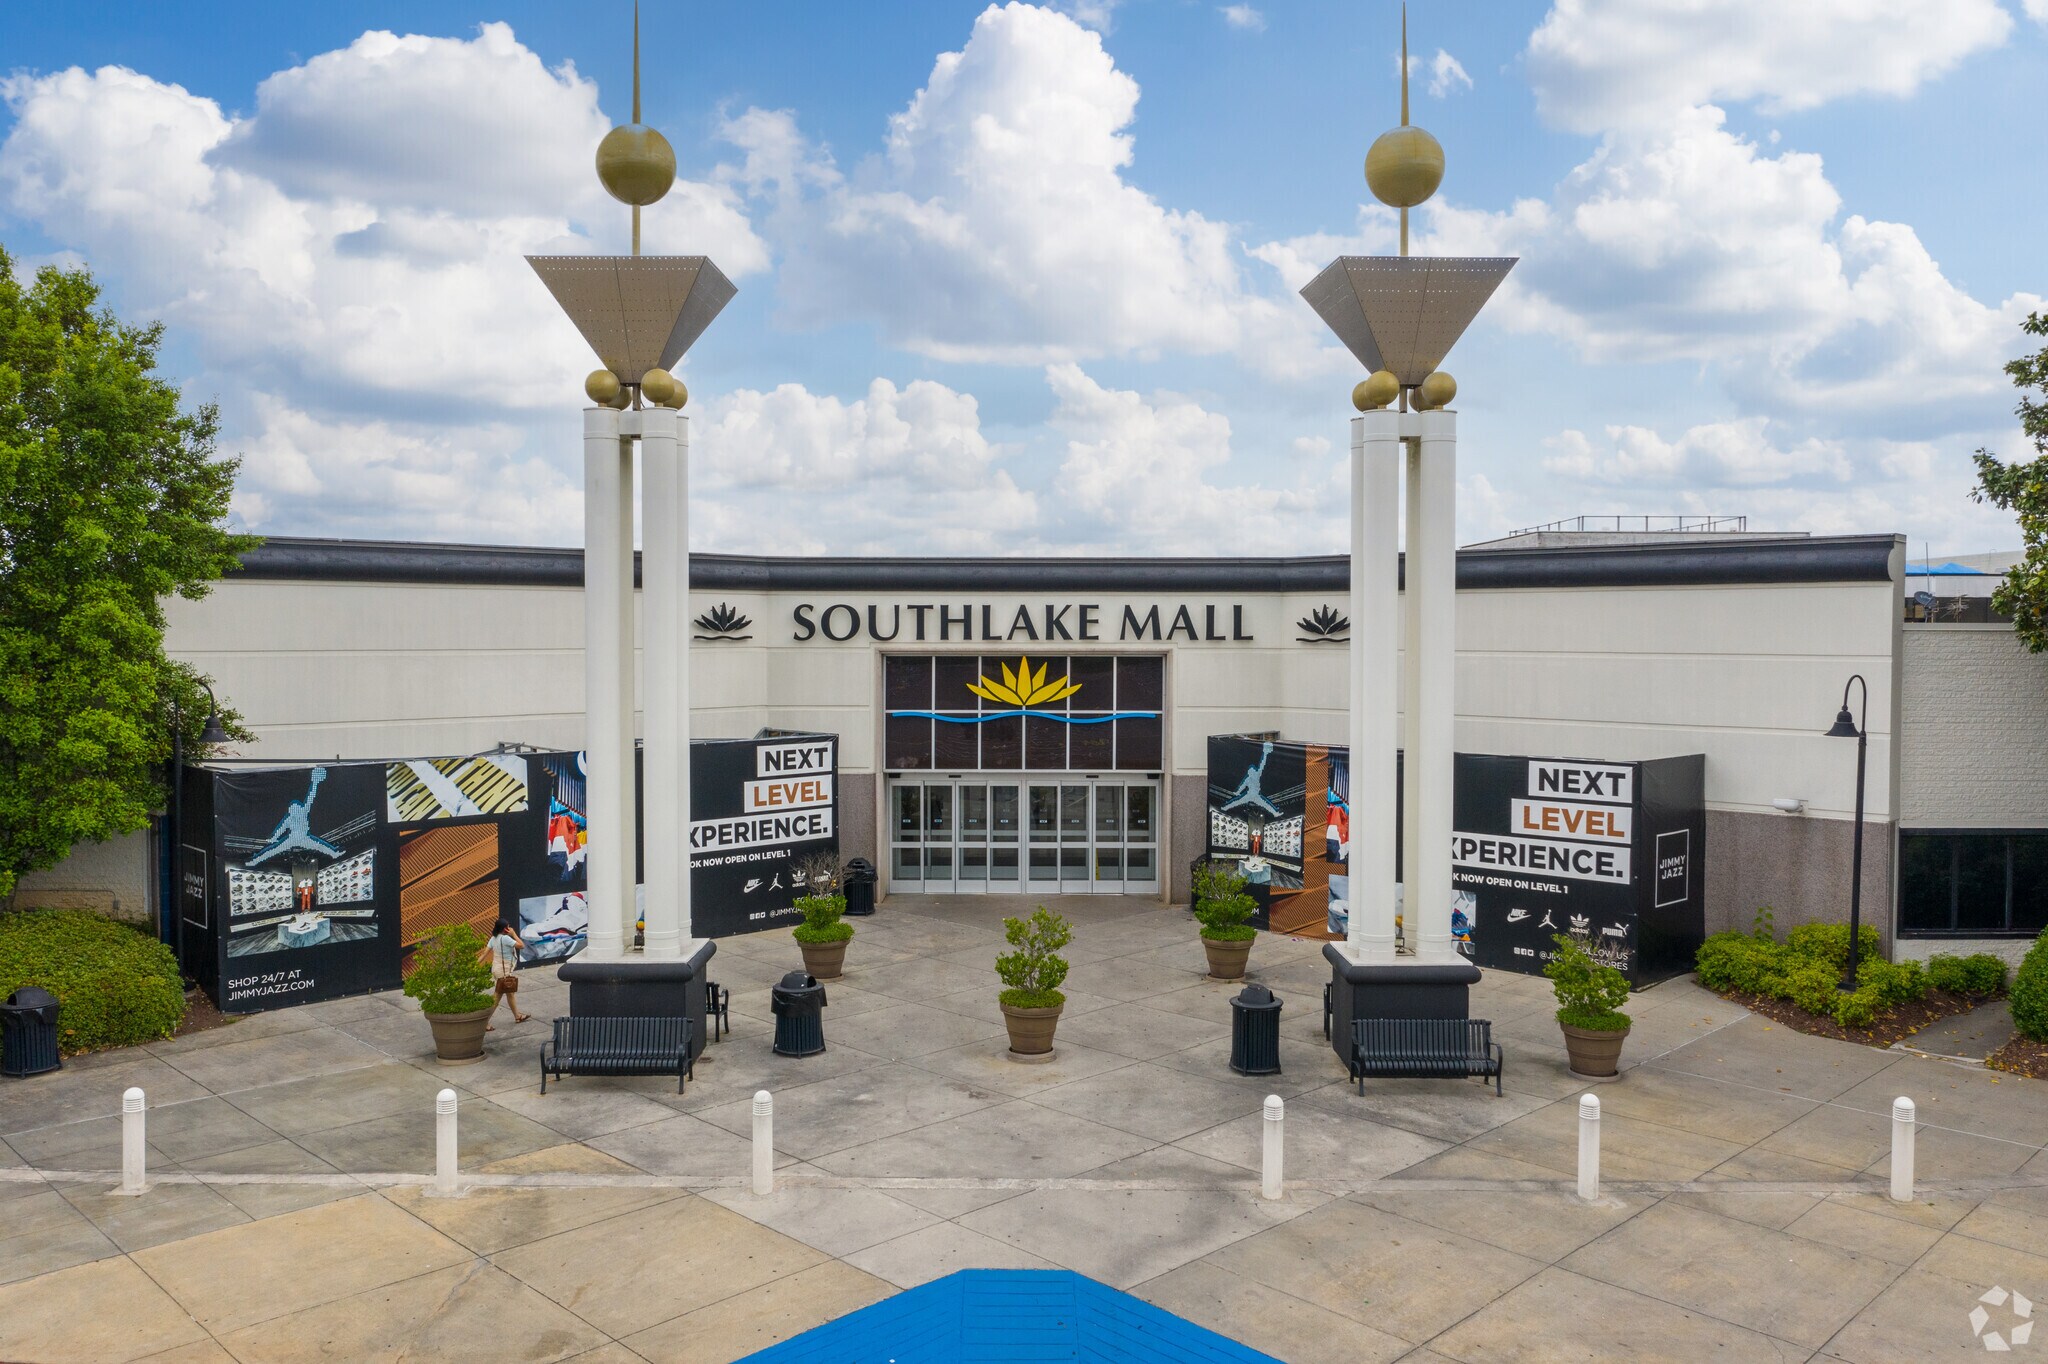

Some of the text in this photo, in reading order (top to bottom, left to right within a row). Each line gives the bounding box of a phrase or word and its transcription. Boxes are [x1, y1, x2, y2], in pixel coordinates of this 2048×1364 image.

[793, 603, 1254, 642] SOUTHLAKE MALL
[764, 747, 828, 772] NEXT
[1538, 767, 1626, 797] NEXT
[753, 780, 828, 807] LEVEL
[690, 814, 828, 848] XPERIENCE.
[1523, 805, 1625, 838] LEVEL
[690, 860, 702, 869] OK
[703, 857, 724, 867] NOW
[724, 854, 747, 864] OPEN
[748, 853, 761, 862] ON
[762, 850, 786, 860] LEVEL
[1659, 854, 1686, 869] JIMMY
[184, 871, 204, 887] JIMMY
[1461, 873, 1485, 884] NOW
[1486, 876, 1512, 888] OPEN
[1514, 880, 1529, 890] ON
[1530, 882, 1562, 894] LEVEL
[1563, 885, 1569, 894] 1
[1661, 866, 1683, 880] JAZZ
[185, 884, 203, 899] JAZZ
[1616, 951, 1629, 960] US
[228, 969, 302, 989] SHOP 24/7 AT
[228, 979, 315, 1001] JIMMYJAZZ.COM
